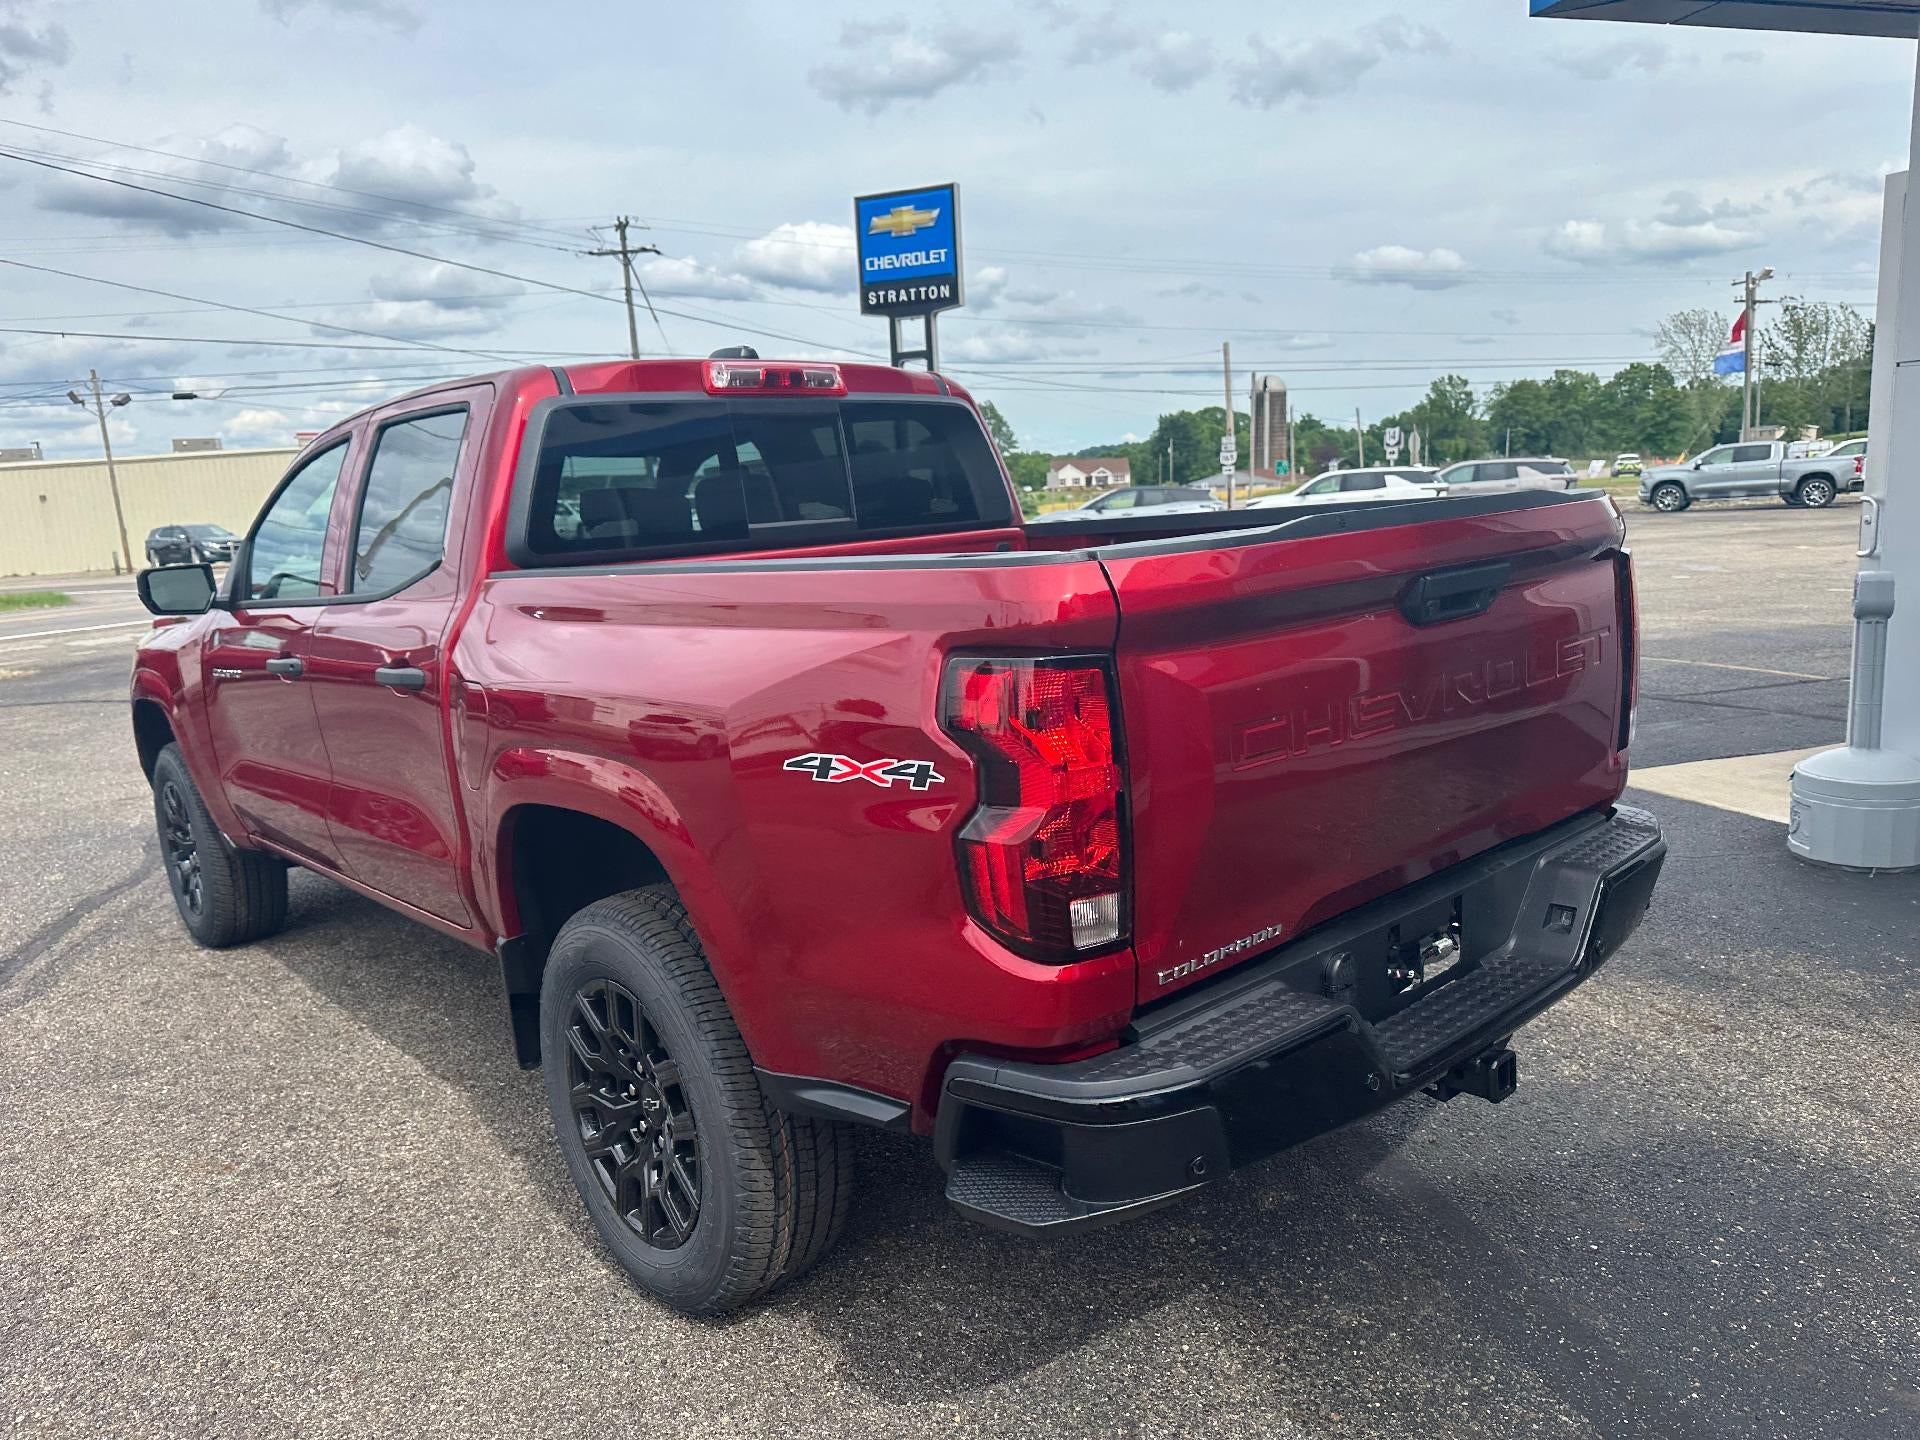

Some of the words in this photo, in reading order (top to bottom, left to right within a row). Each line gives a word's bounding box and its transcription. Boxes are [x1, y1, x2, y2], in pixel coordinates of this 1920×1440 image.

[865, 248, 948, 271] CHEVROLET
[868, 284, 950, 304] STRATTON
[1229, 625, 1611, 772] CHEVROLET
[1158, 924, 1283, 985] COLORADO
